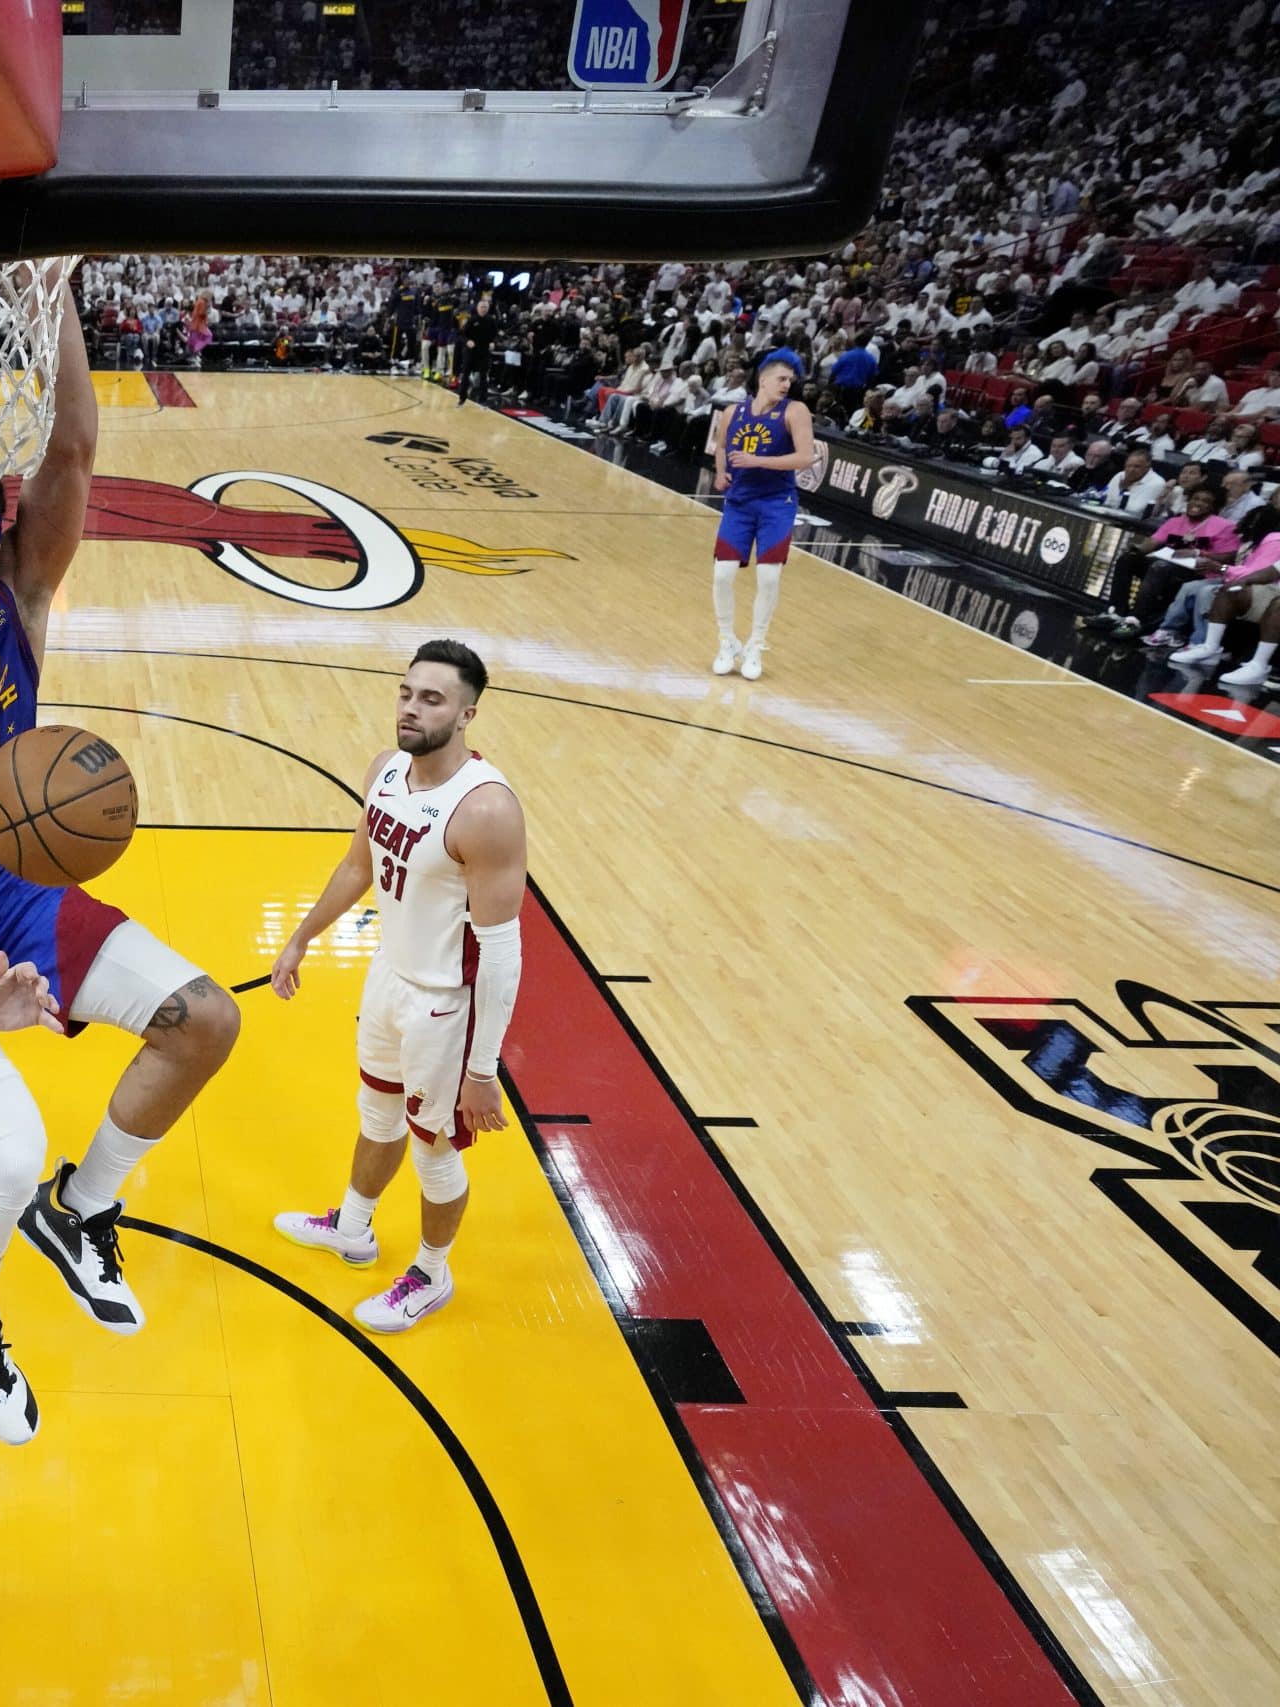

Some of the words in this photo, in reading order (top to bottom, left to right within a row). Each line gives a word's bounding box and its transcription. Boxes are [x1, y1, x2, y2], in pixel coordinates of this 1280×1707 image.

[585, 26, 638, 70] NBA
[742, 435, 760, 454] 15
[383, 455, 470, 497] Center
[440, 457, 540, 499] Kaseya
[829, 458, 862, 494] GAME
[859, 467, 872, 497] 4
[923, 487, 980, 535] FRIDAY
[975, 505, 1019, 549] 8:30
[1012, 516, 1043, 556] ET
[1043, 536, 1066, 554] abc
[421, 803, 440, 818] UKG
[366, 803, 432, 863] HEAT
[379, 855, 408, 902] 31
